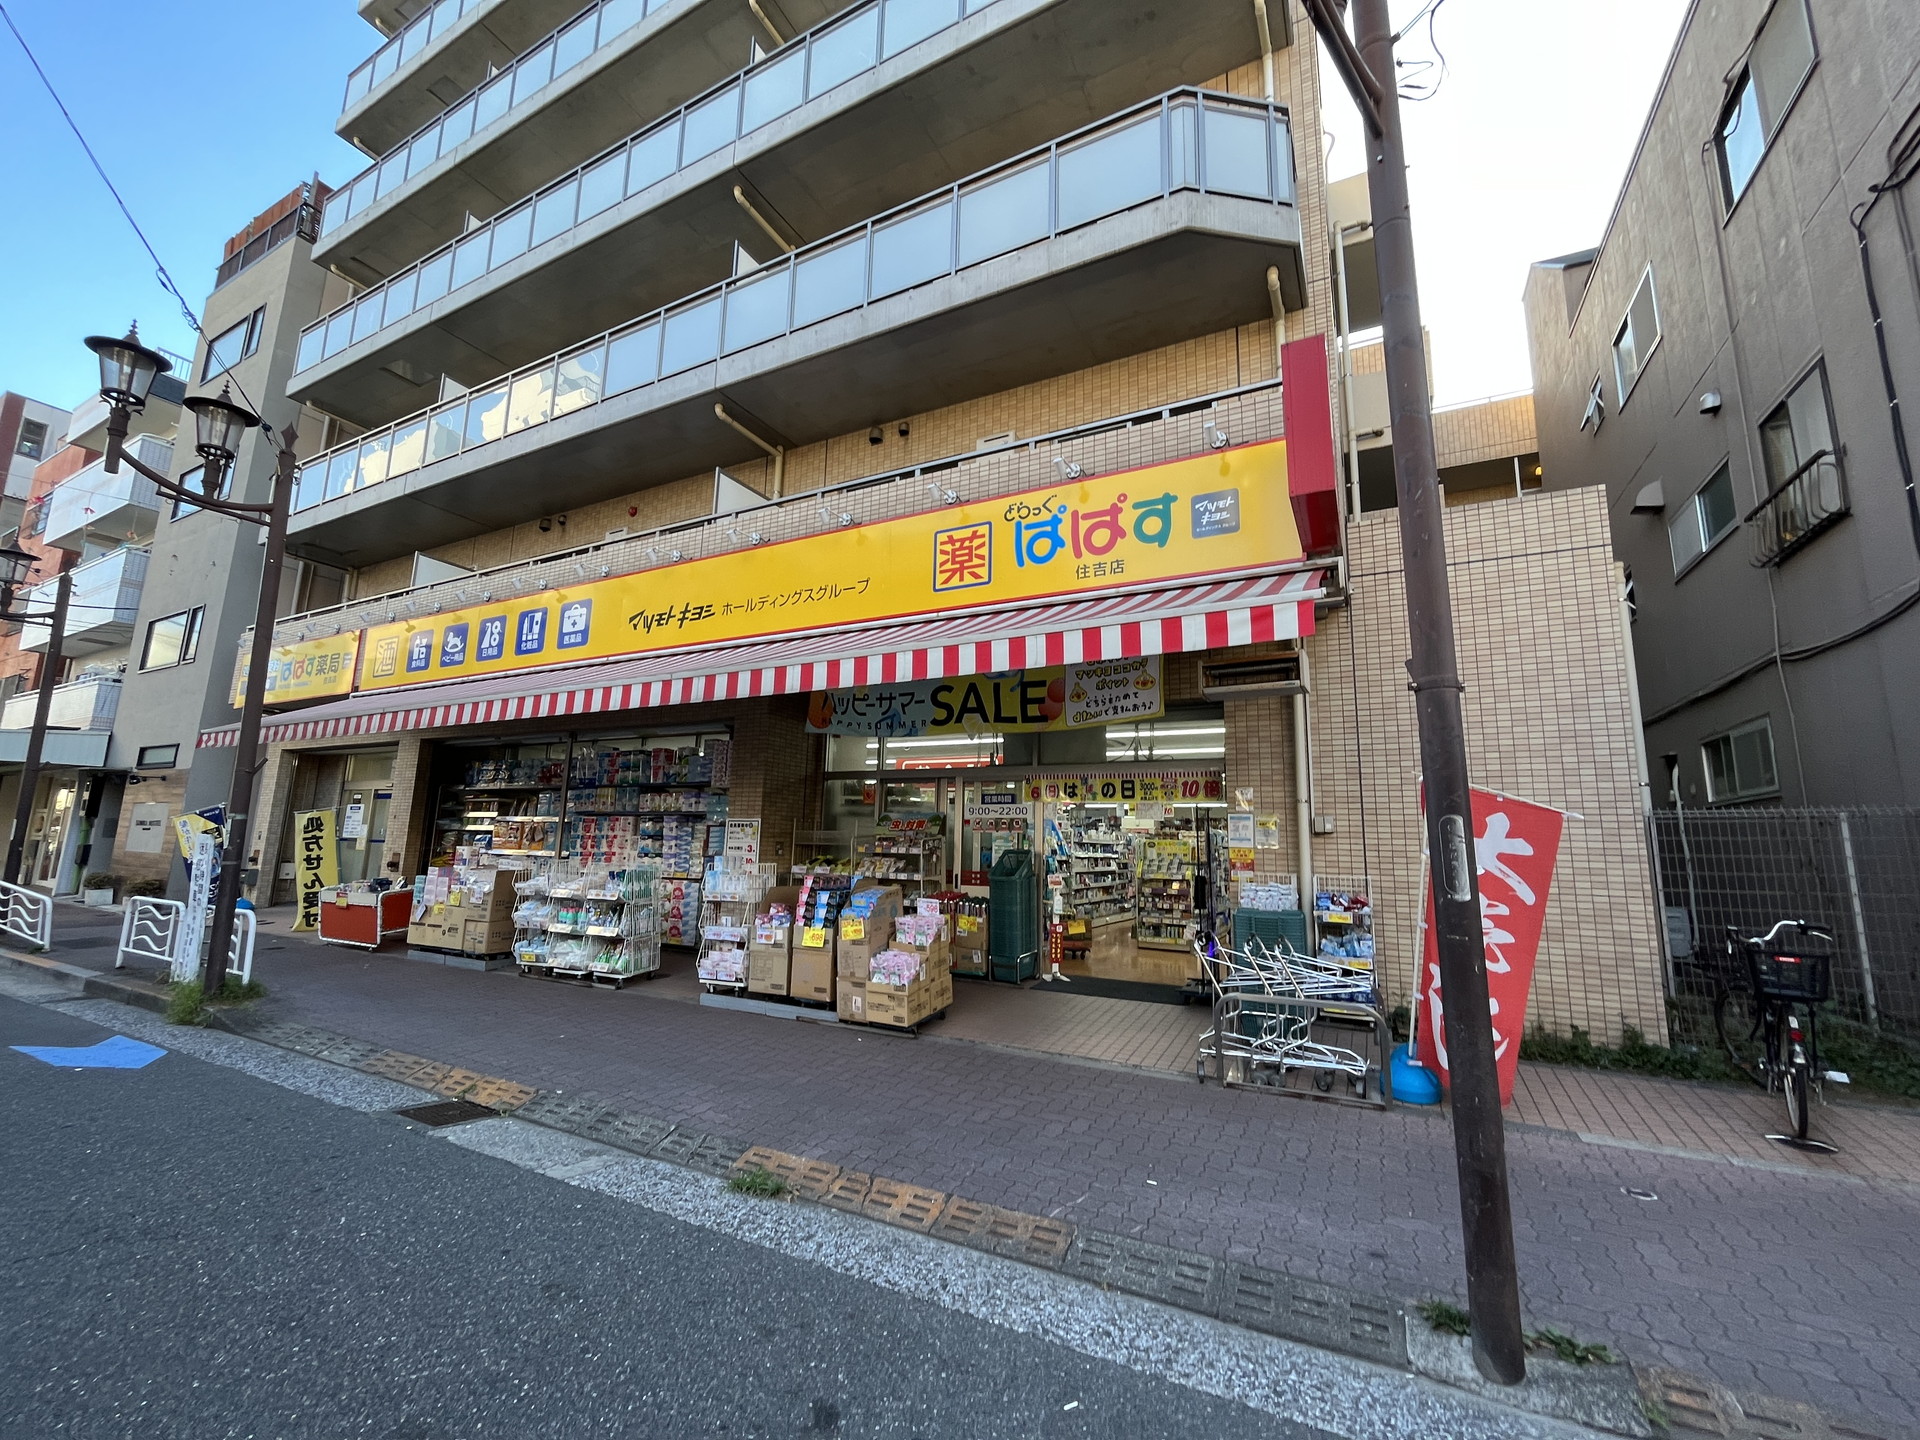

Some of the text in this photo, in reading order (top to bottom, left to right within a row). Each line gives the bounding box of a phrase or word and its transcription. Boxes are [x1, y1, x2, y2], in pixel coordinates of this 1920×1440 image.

[1003, 494, 1058, 523] どらっぐ
[1195, 496, 1235, 512] マツモト
[1015, 492, 1179, 568] ぱぱす
[1200, 511, 1231, 526] キヨシ
[938, 528, 988, 587] 薬
[1075, 559, 1126, 581] 住吉店
[628, 577, 872, 635] マツモトキヨシ ホールディングスグループ
[520, 639, 539, 651] 化粧品
[563, 632, 582, 644] 医薬品
[376, 641, 396, 674] 酒
[481, 646, 498, 657] 日用品
[821, 680, 1050, 727] ハッピーサマー SALE
